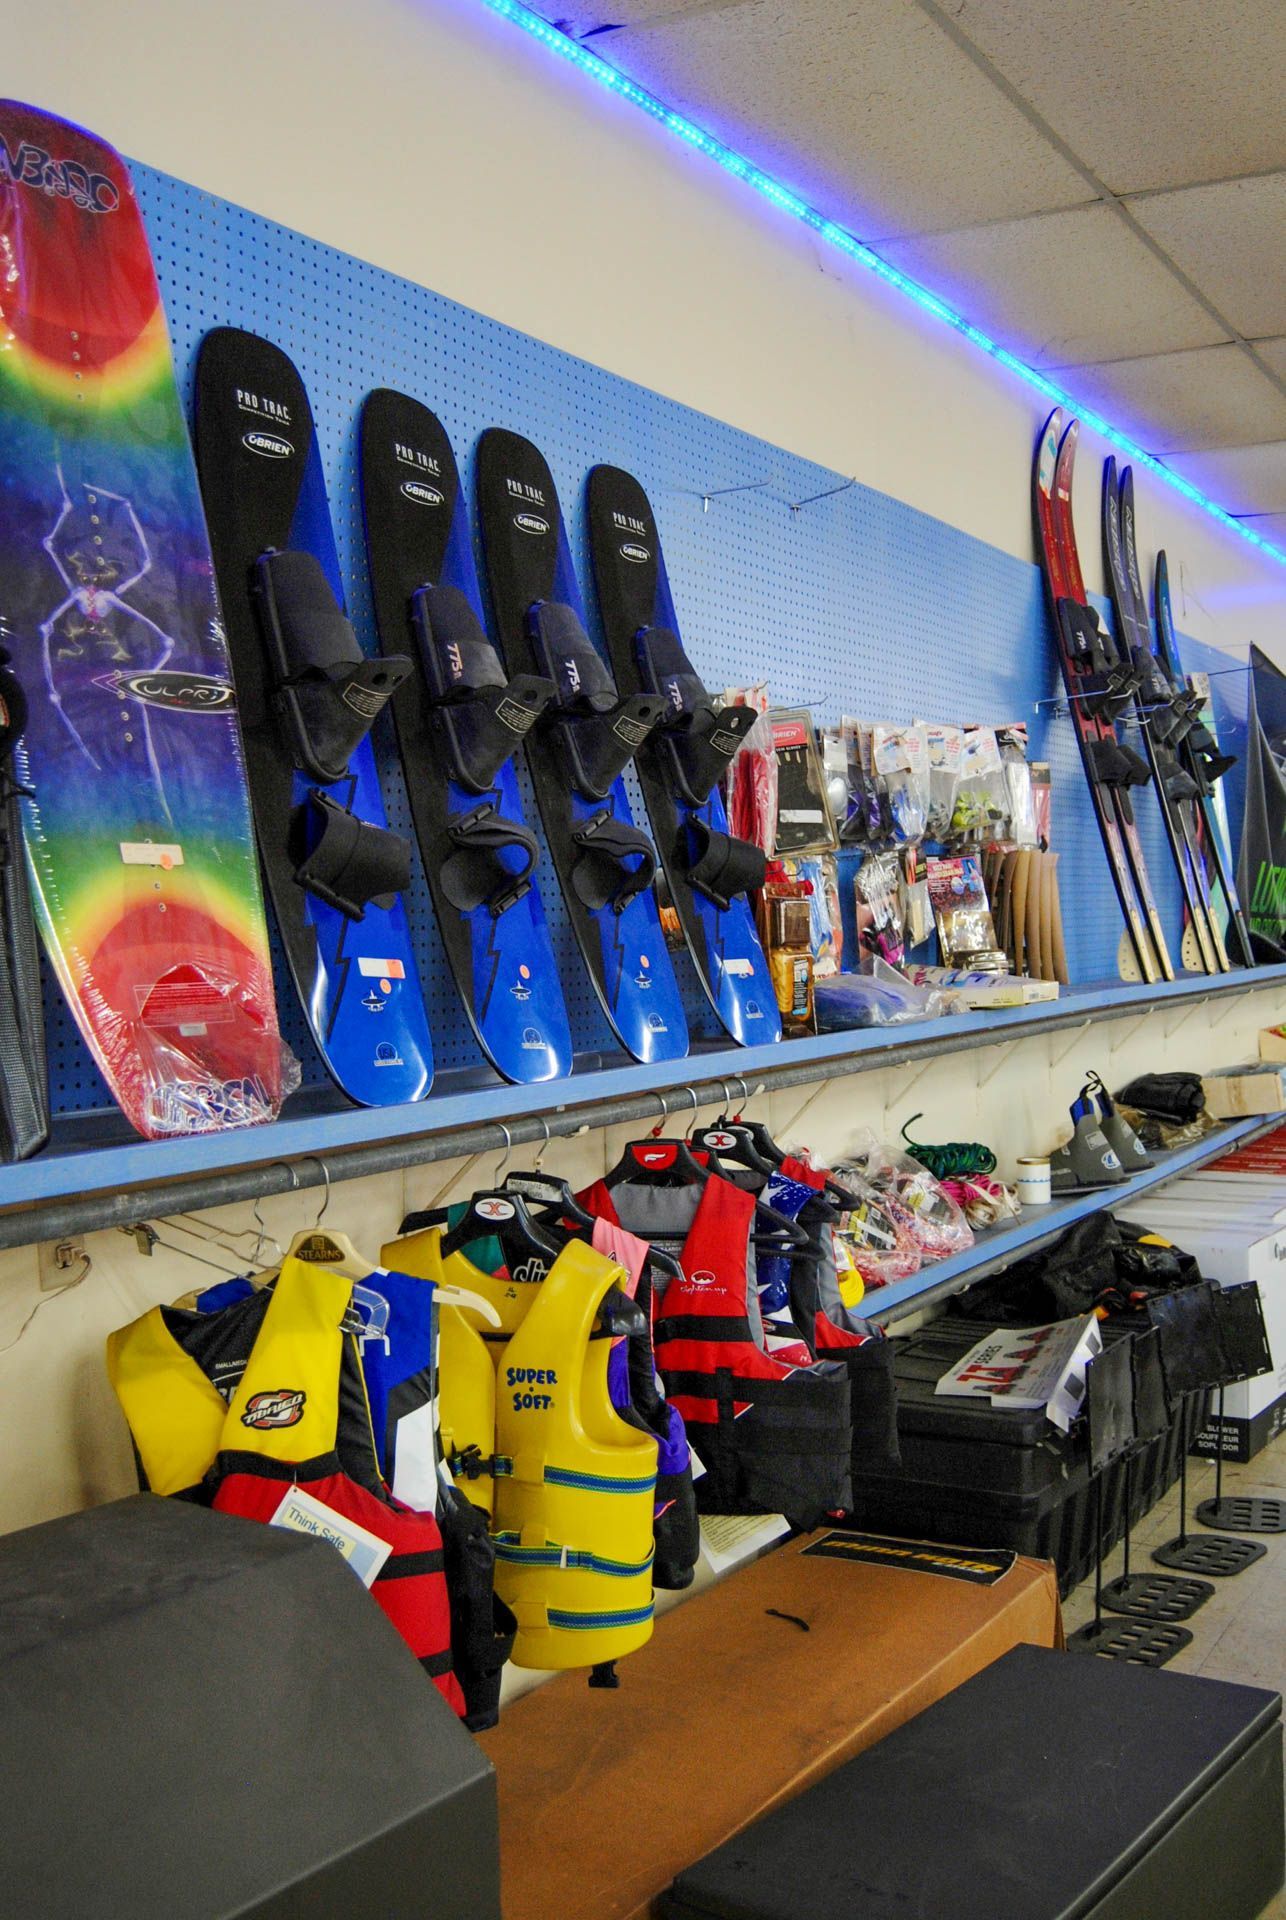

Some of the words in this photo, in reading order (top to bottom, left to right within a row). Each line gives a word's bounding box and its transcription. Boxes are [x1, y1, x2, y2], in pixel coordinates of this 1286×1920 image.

[236, 389, 259, 409] PRO
[262, 397, 290, 420] TRAC
[394, 443, 414, 461] PRO
[416, 452, 440, 473] TRAC
[298, 1249, 341, 1261] STEARNS
[506, 1366, 558, 1387] SUPER
[512, 1391, 552, 1412] SOFT
[1206, 1424, 1239, 1435] BLWER
[1198, 1440, 1239, 1452] SOPLDOR
[288, 1507, 319, 1534] Think
[319, 1527, 345, 1550] Safe
